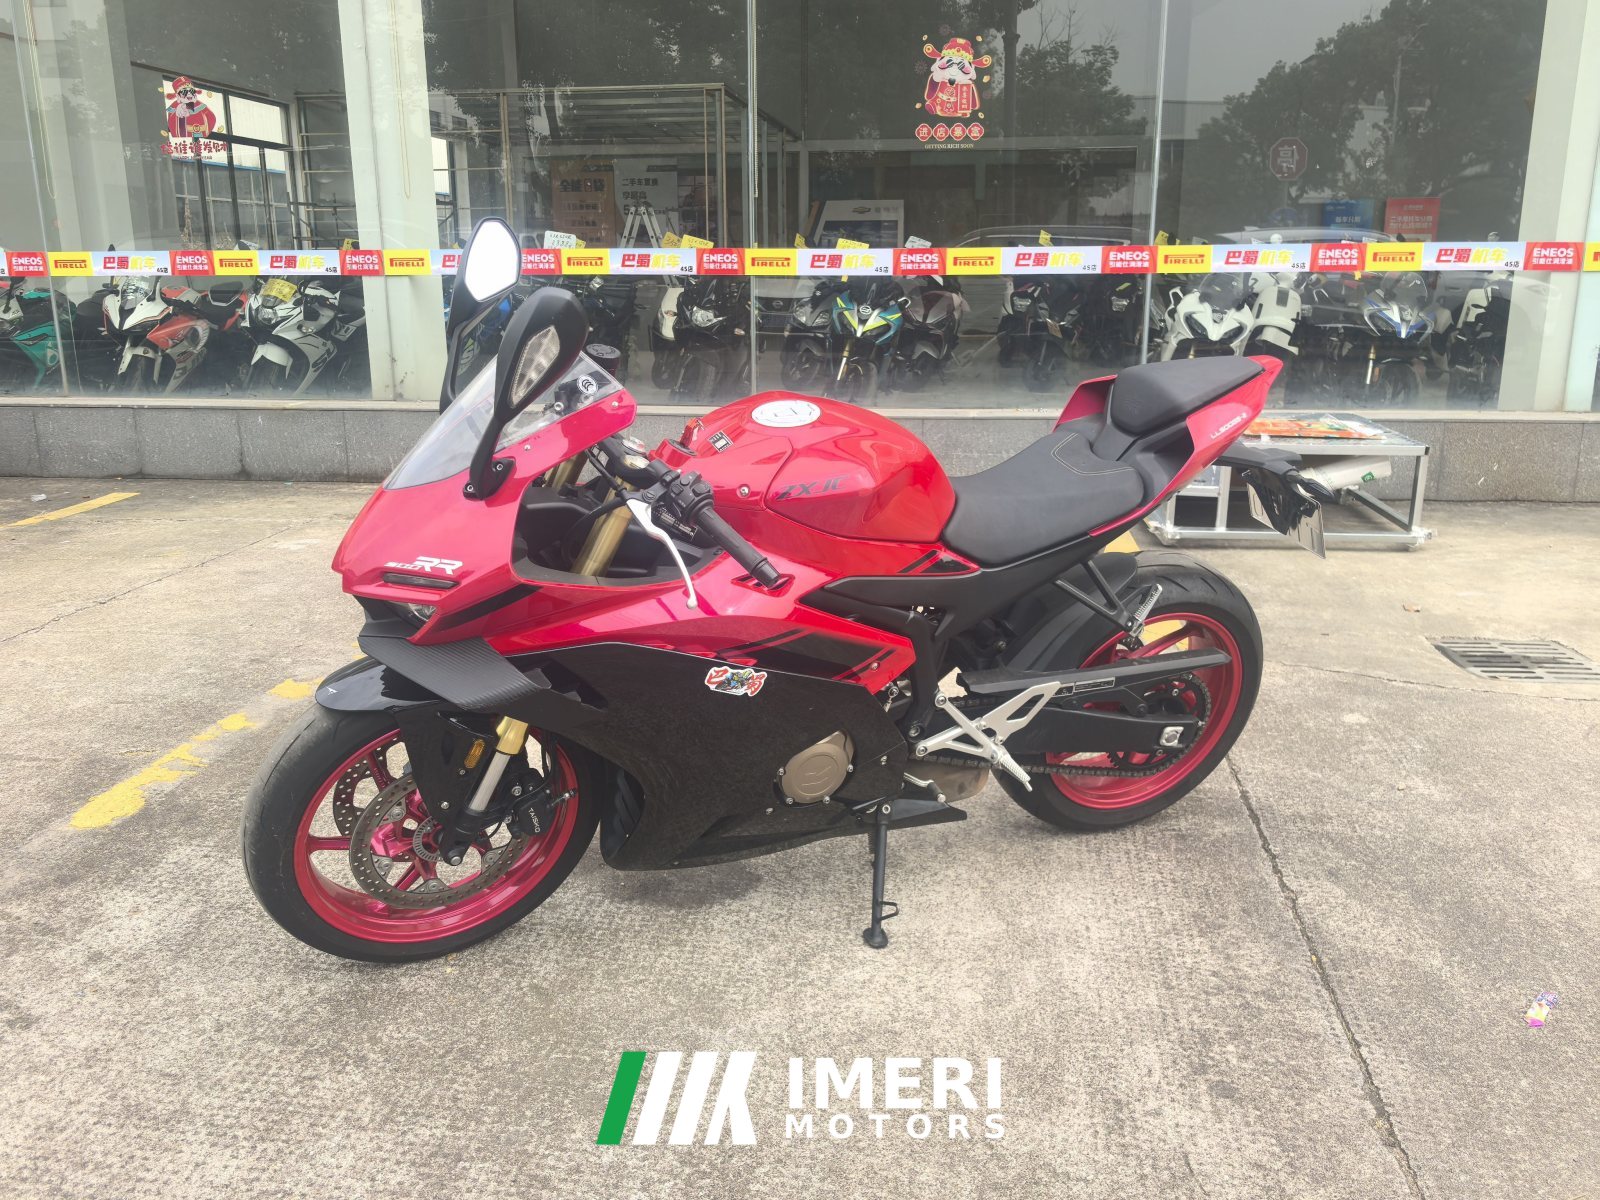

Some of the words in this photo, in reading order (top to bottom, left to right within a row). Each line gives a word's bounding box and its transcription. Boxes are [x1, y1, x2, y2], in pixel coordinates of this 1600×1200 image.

[522, 254, 554, 262] ENEOS
[703, 253, 738, 262] ENEOS
[901, 253, 939, 262] ENEOS
[1109, 251, 1150, 261] ENEOS
[1224, 250, 1295, 265] 巴蜀机车
[1318, 249, 1359, 259] ENEOS
[1372, 252, 1415, 262] PIRELLI
[1436, 248, 1508, 263] 巴蜀机车
[1533, 248, 1574, 258] ENEOS
[54, 260, 87, 268] PIRELLI
[103, 256, 156, 270] 巴蜀机车
[176, 256, 207, 264] ENEOS
[219, 258, 253, 267] PIRELLI
[270, 255, 325, 269] 巴蜀机车
[346, 255, 378, 263] ENEOS
[390, 257, 425, 267] PIRELLI
[567, 256, 603, 266] PIRELLI
[621, 253, 681, 268] 巴蜀机车
[751, 257, 791, 267] PIRELLI
[810, 254, 876, 269] 巴蜀机车
[953, 256, 994, 266] PIRELLI
[1014, 252, 1084, 267] 巴蜀机车
[1164, 254, 1205, 264] PIRELLI
